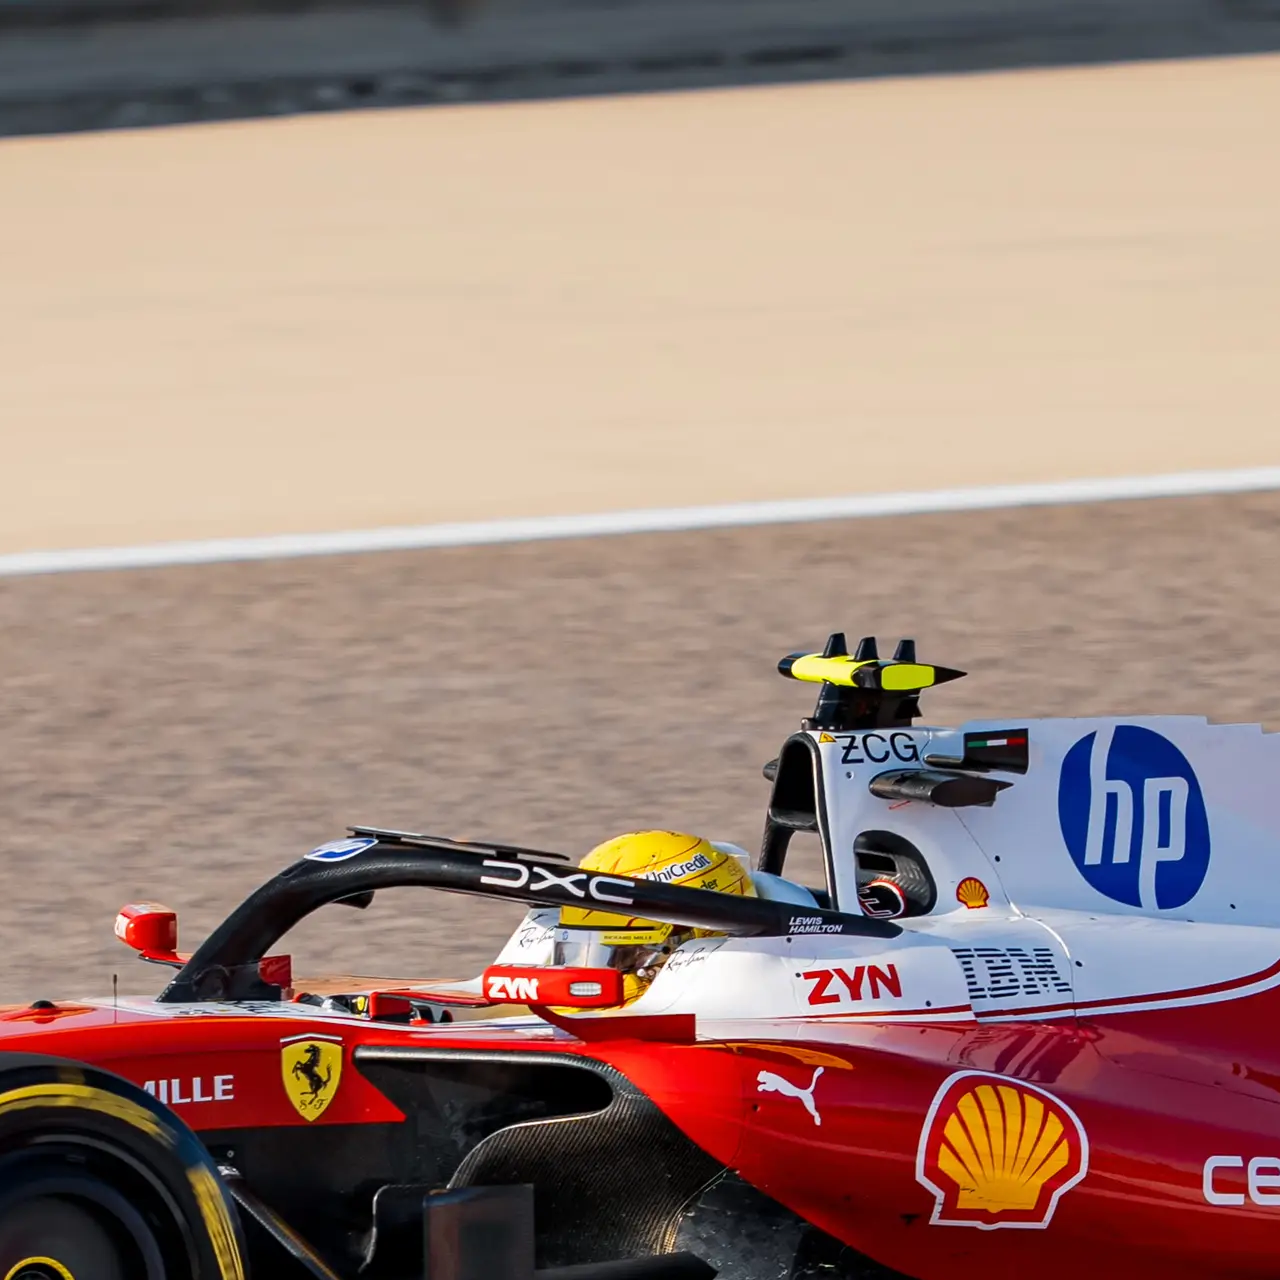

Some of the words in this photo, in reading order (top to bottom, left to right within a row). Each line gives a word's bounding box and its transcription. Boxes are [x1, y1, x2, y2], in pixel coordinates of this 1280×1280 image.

[1084, 726, 1189, 909] hp
[480, 859, 635, 905] DXC
[789, 916, 823, 925] LEWIS
[789, 924, 843, 933] HAMILTON
[488, 976, 539, 1000] ZYN
[802, 963, 902, 1005] ZYN
[951, 948, 1073, 1000] IBM
